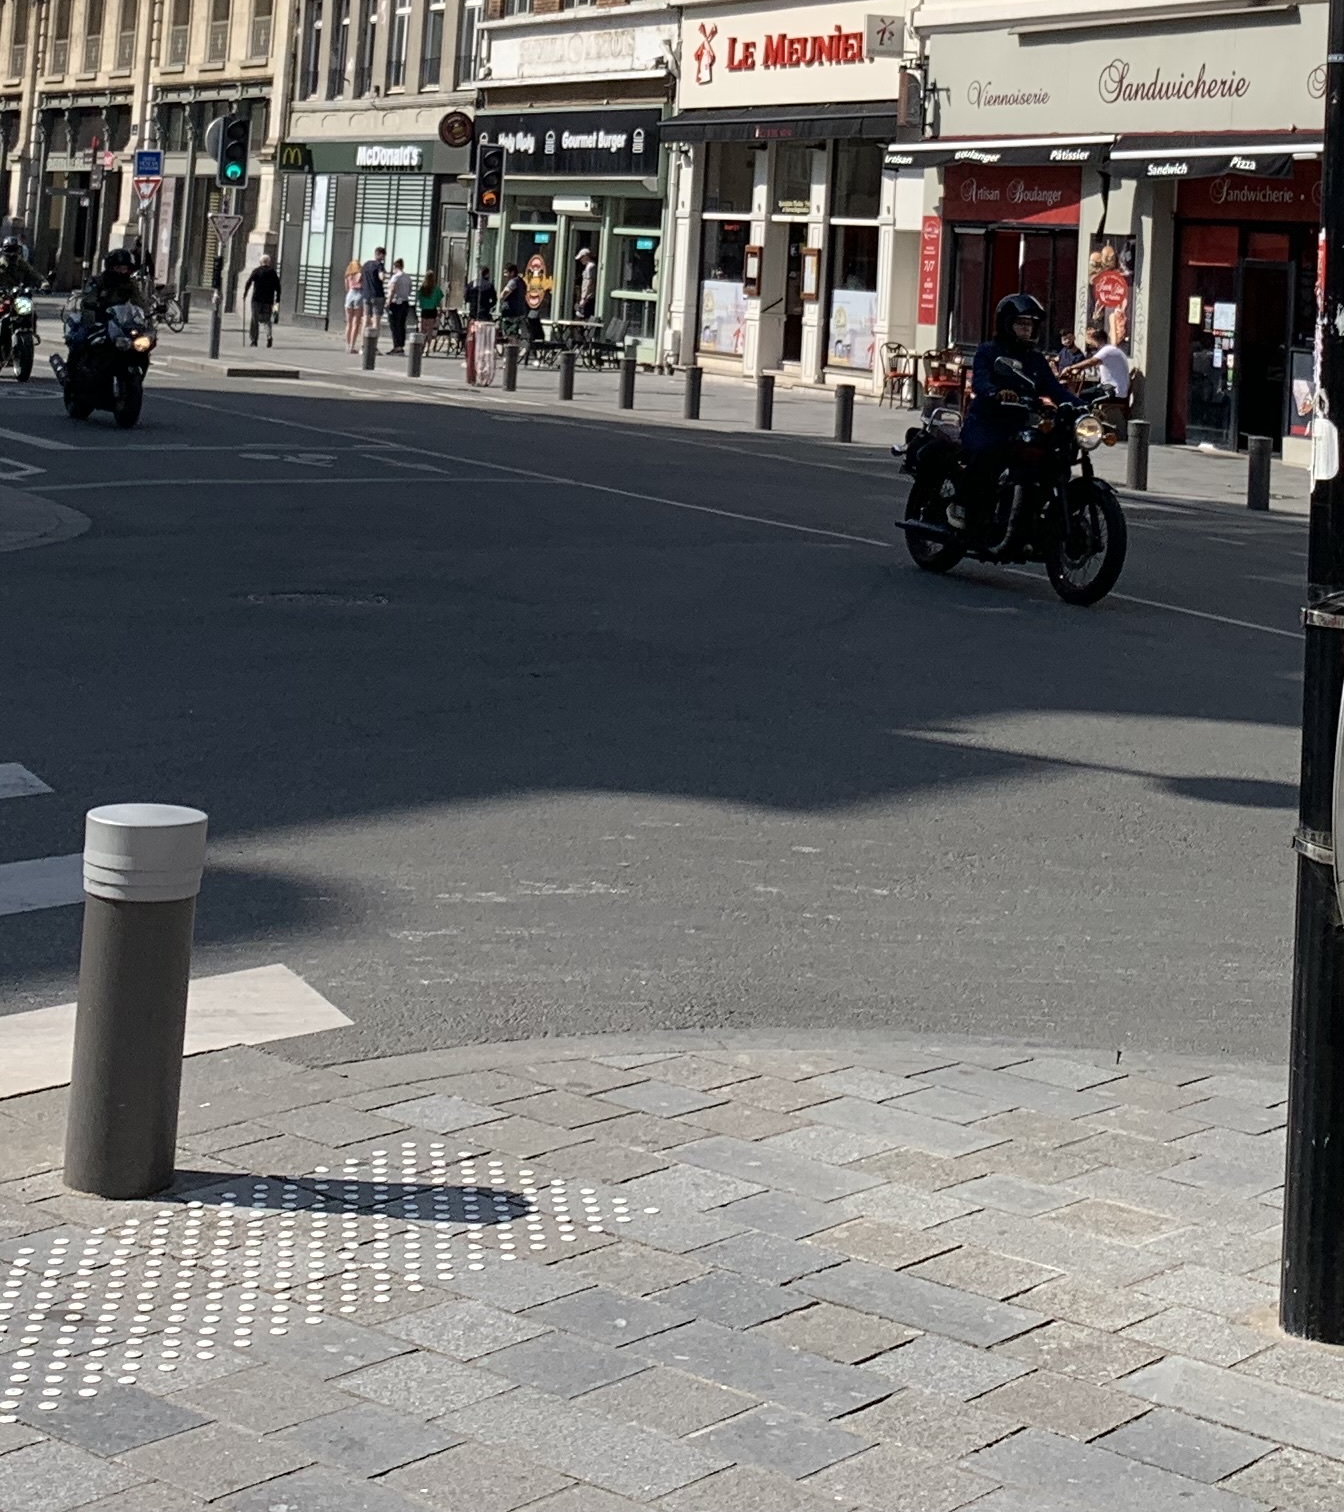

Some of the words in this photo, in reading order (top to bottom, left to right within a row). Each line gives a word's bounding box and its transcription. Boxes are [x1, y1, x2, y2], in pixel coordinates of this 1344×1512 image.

[1099, 58, 1251, 105] Sandwicherie
[967, 80, 1051, 109] Viennoiserie
[561, 131, 597, 150] Gourmet
[598, 130, 627, 153] Burger
[356, 145, 421, 168] McDonald's
[1049, 148, 1091, 161] Pâtissier
[1229, 156, 1256, 170] Pizza
[1146, 163, 1188, 176] Sandwich
[960, 178, 1000, 204] Artisan
[1006, 178, 1062, 205] Boulanger
[1209, 177, 1294, 204] Sandwicherie
